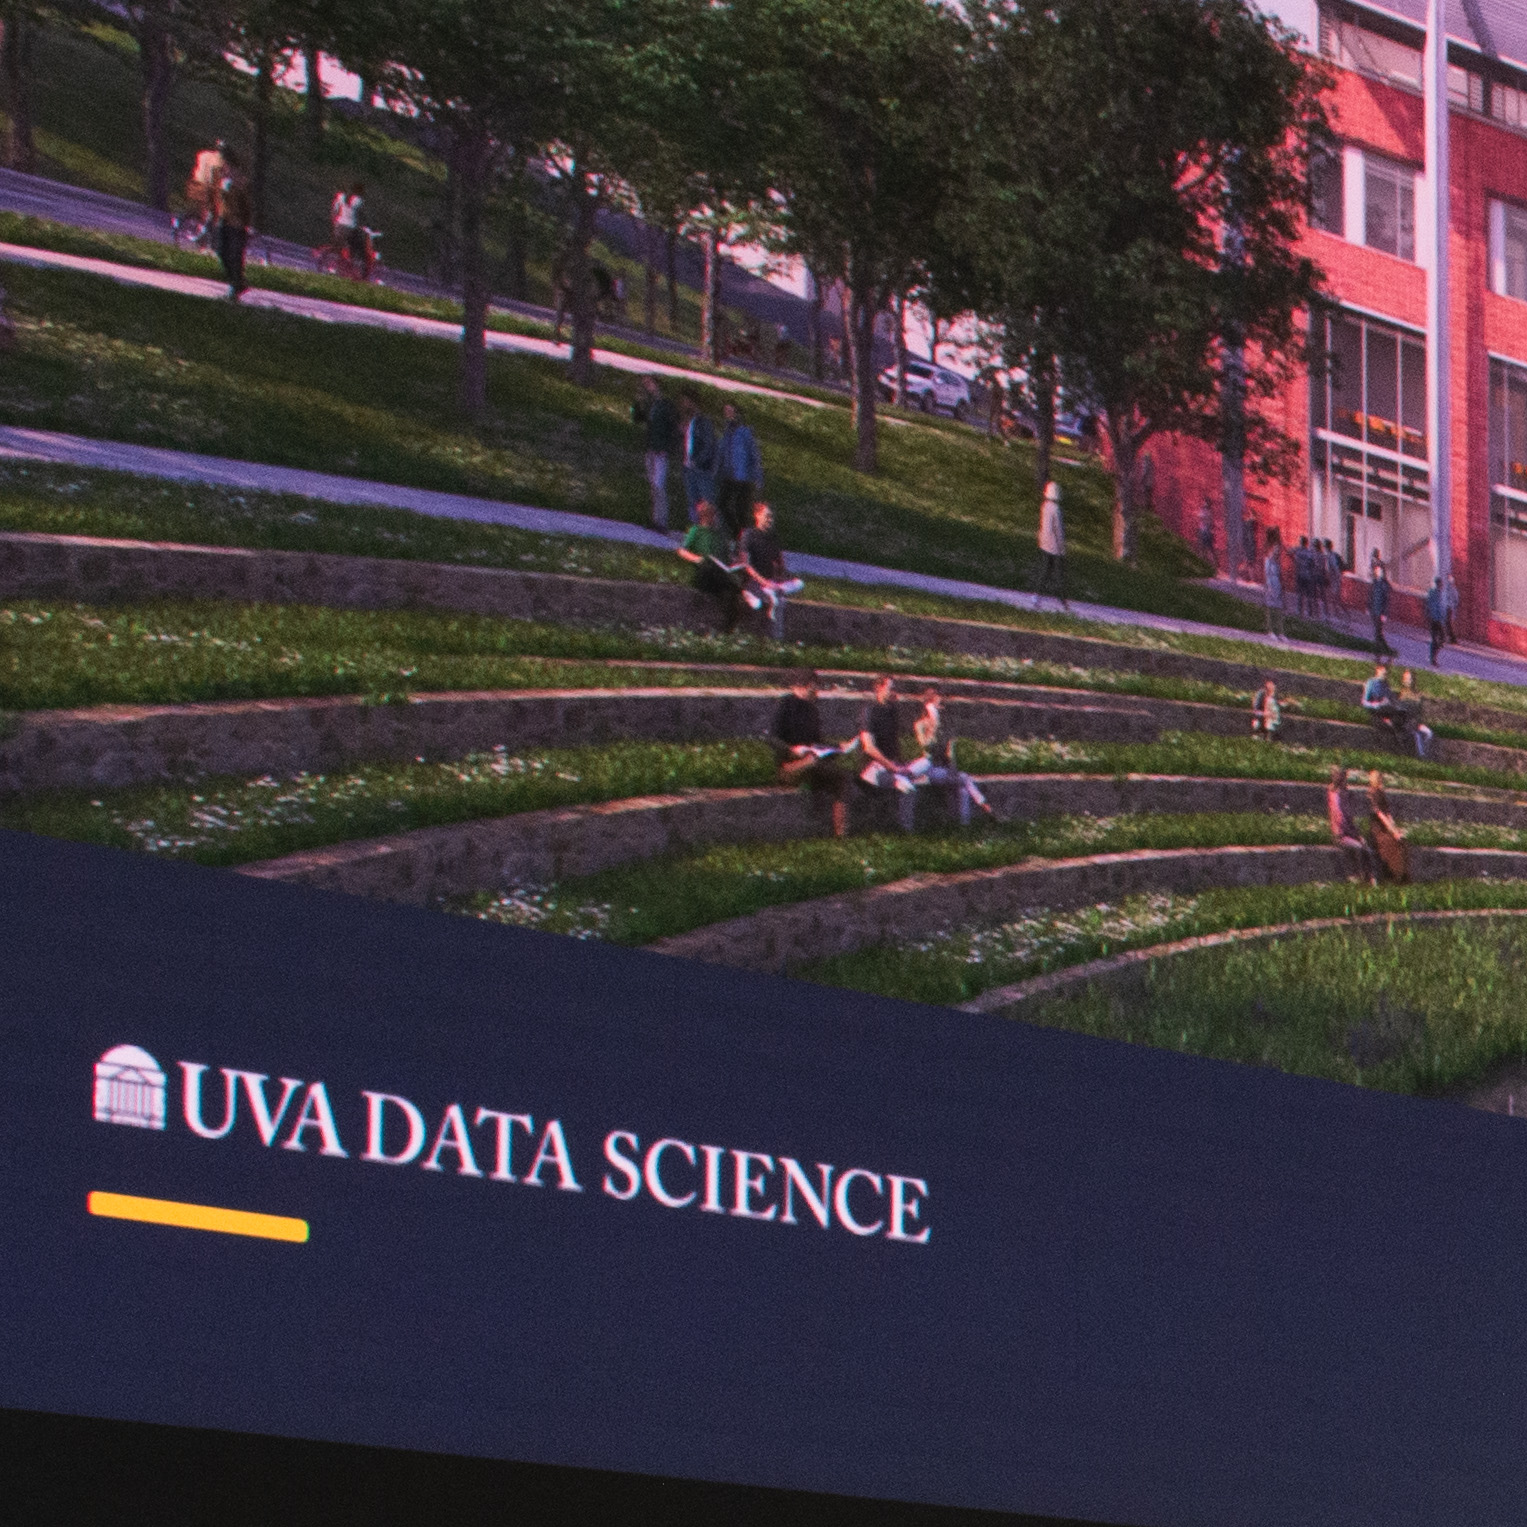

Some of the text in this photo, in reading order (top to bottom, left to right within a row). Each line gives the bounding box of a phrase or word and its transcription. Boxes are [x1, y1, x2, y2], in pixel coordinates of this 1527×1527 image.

[179, 1061, 932, 1244] UVA DATA SCIENCE
